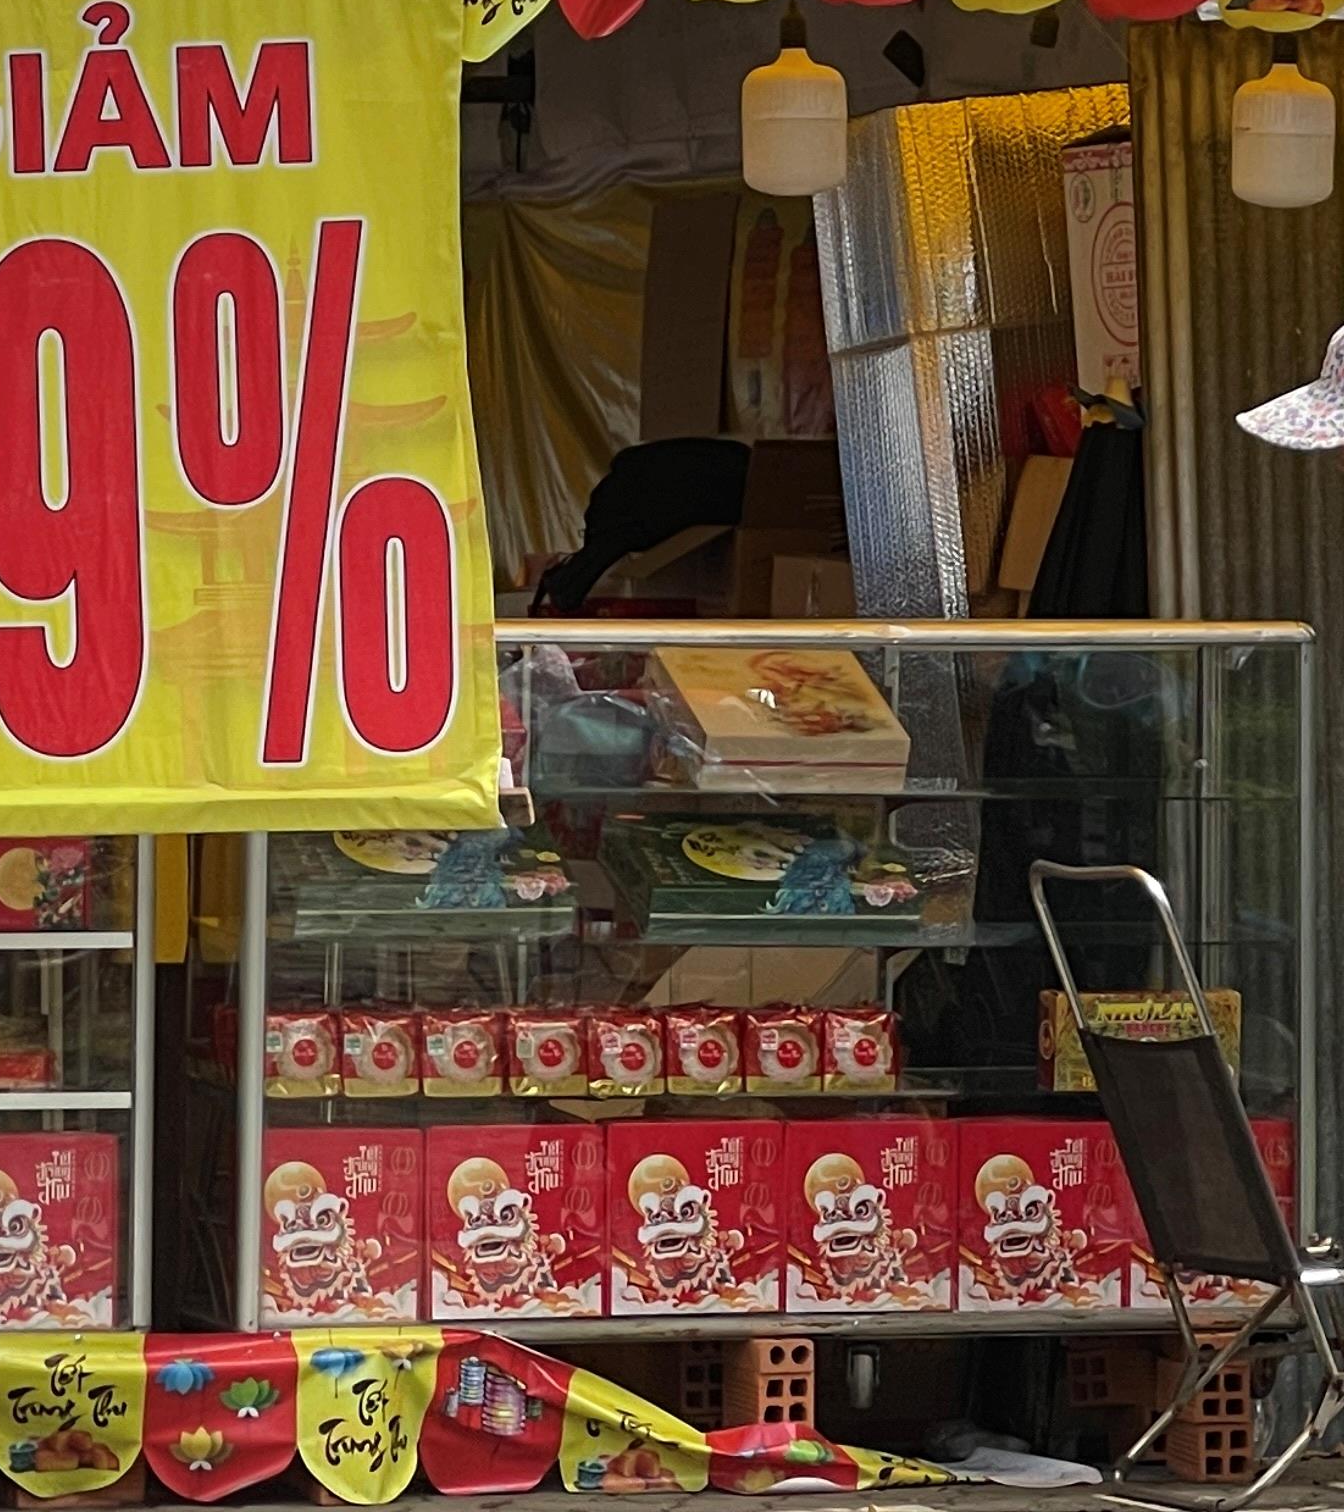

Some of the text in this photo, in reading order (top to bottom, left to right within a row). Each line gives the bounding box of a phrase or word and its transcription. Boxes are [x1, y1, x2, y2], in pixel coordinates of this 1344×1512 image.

[44, 1353, 93, 1396] Tết
[7, 1384, 128, 1432] Trung Thu
